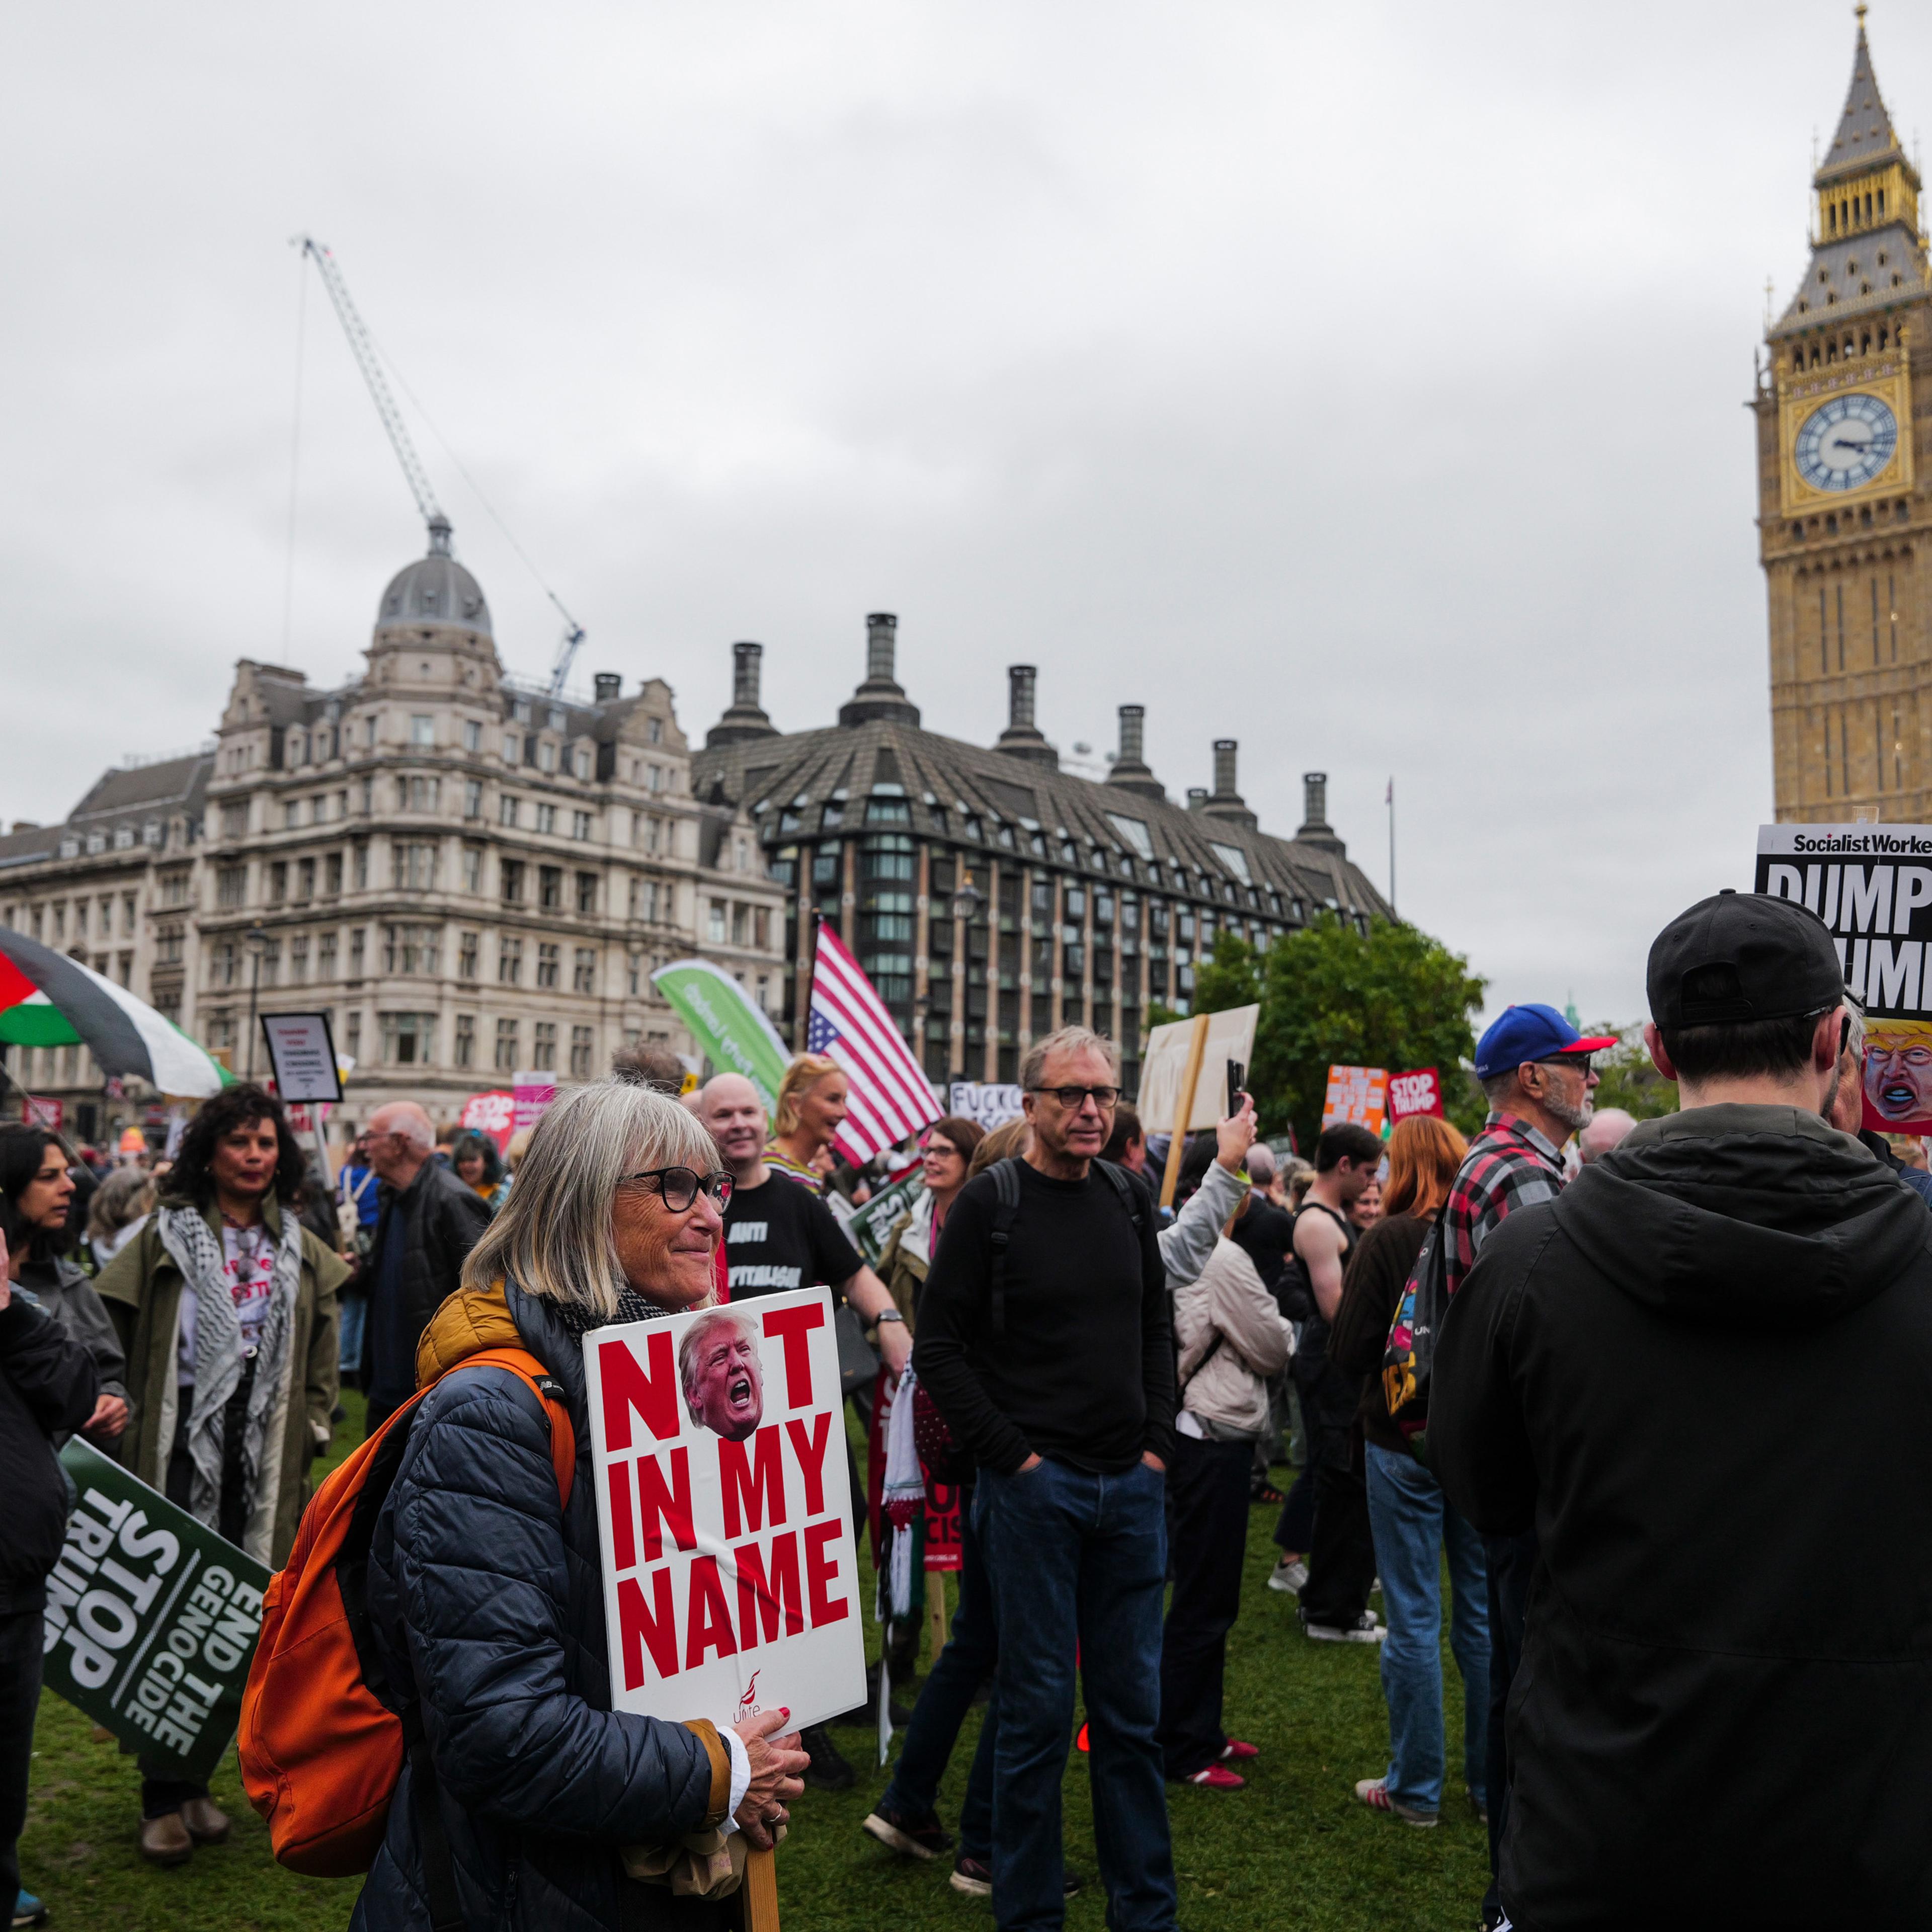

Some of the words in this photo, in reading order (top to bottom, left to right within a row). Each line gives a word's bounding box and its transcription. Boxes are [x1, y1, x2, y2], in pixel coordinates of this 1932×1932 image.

[1794, 833, 1870, 852] Socialist
[952, 1087, 1006, 1112] FUCK
[1390, 1073, 1434, 1097] STOP
[1392, 1092, 1436, 1115] TRUMP
[727, 1222, 768, 1244] ANTI
[599, 1302, 825, 1453] NT
[608, 1445, 697, 1571] IN
[718, 1411, 832, 1540] MY
[69, 1509, 180, 1689] STOP
[203, 1581, 263, 1672] END
[617, 1517, 849, 1692] NAME
[123, 1565, 235, 1733] GENOCIDE
[152, 1672, 225, 1757] THE
